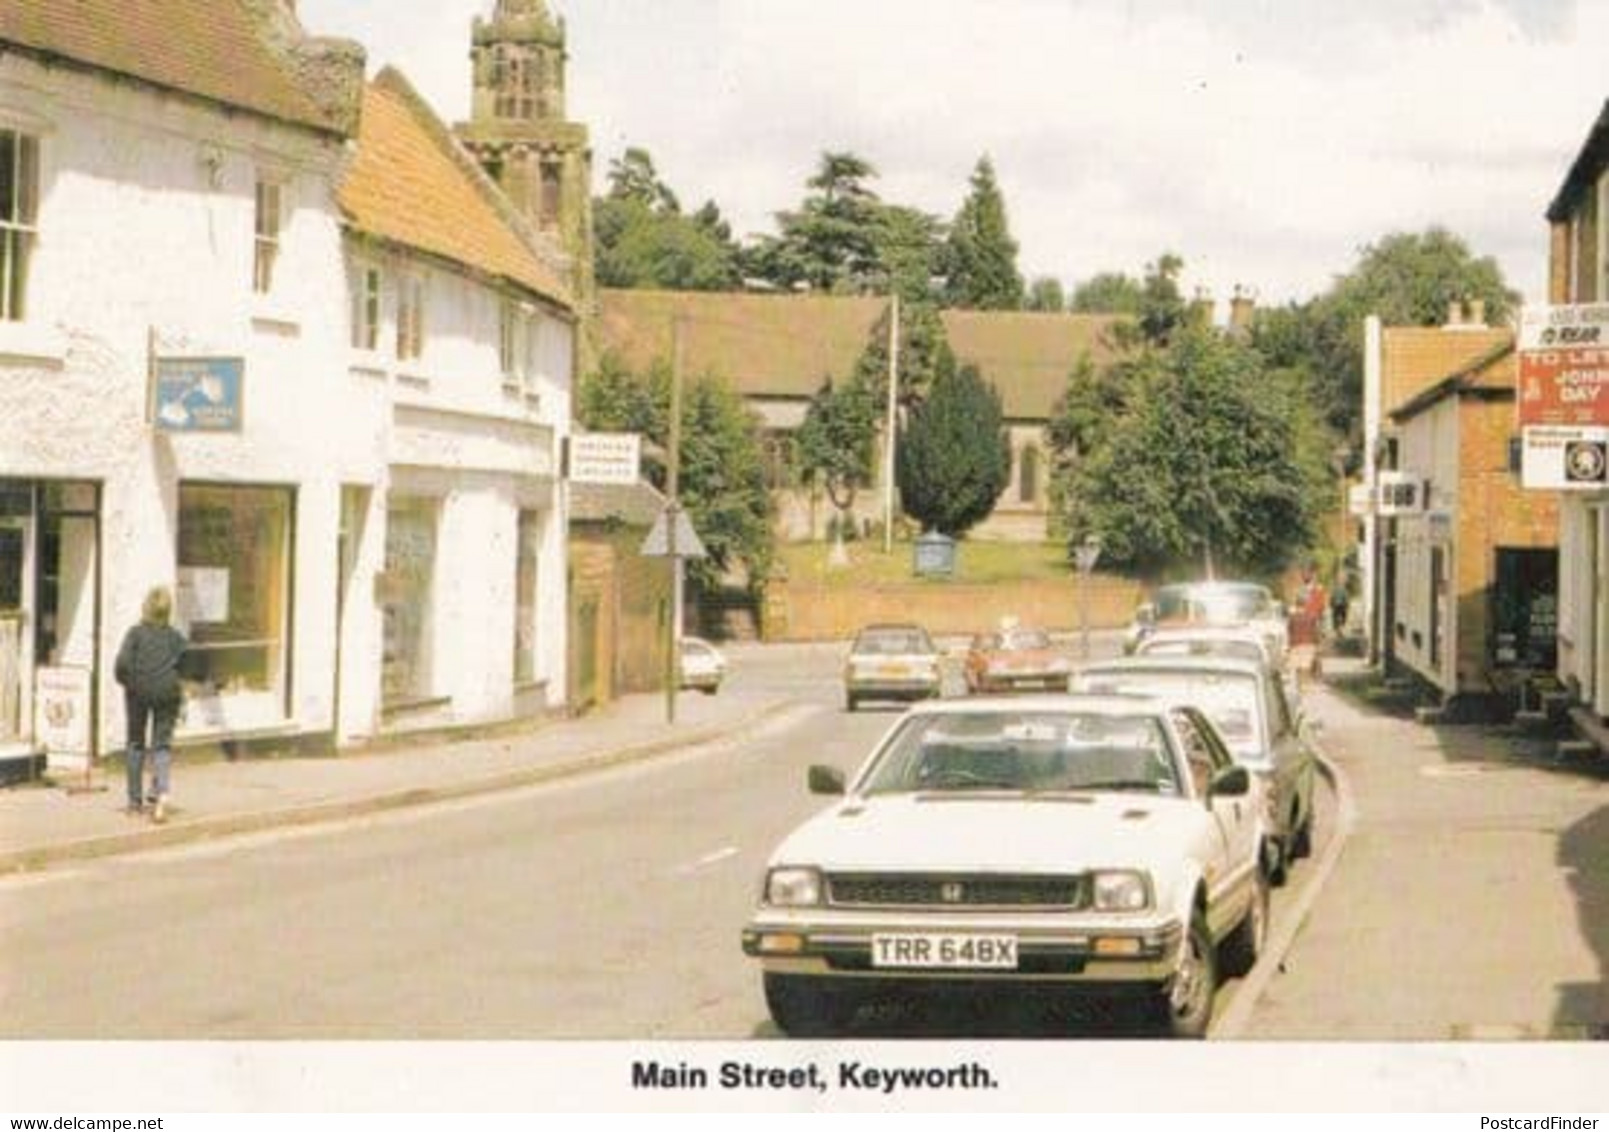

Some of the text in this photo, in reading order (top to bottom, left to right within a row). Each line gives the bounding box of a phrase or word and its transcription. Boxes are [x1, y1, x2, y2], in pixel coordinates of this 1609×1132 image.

[1560, 386, 1601, 401] DAY
[877, 938, 1013, 963] TRR 648X
